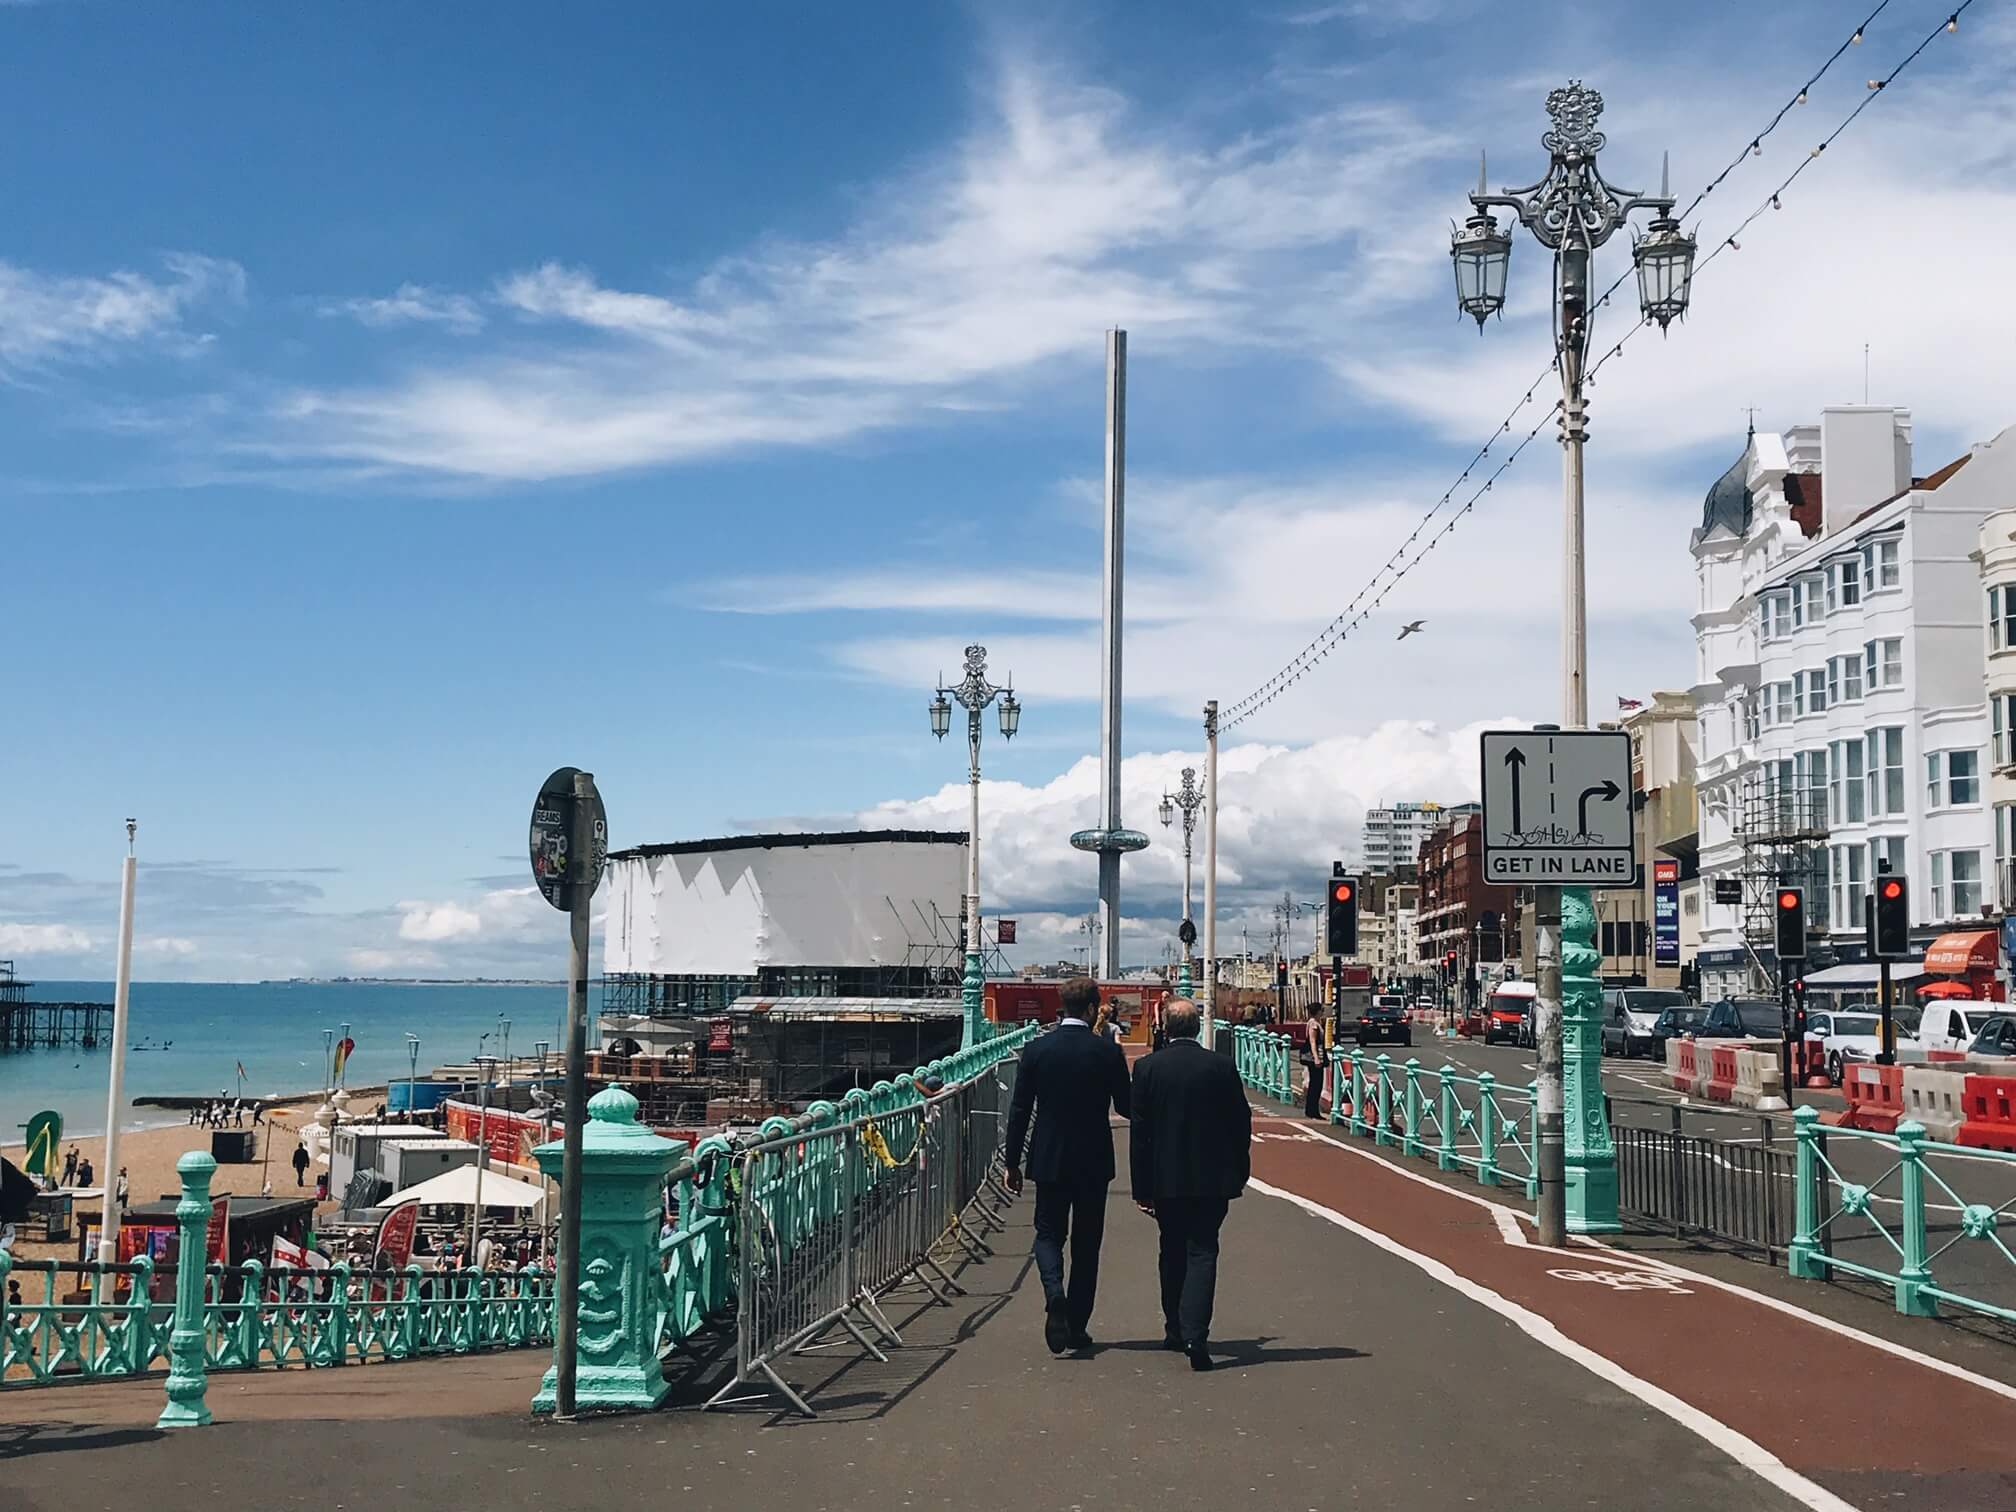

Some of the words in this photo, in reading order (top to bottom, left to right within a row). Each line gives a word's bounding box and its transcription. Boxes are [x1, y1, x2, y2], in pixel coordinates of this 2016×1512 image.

[1493, 857, 1534, 873] GET
[1542, 857, 1563, 873] IN
[1572, 857, 1626, 873] LANE
